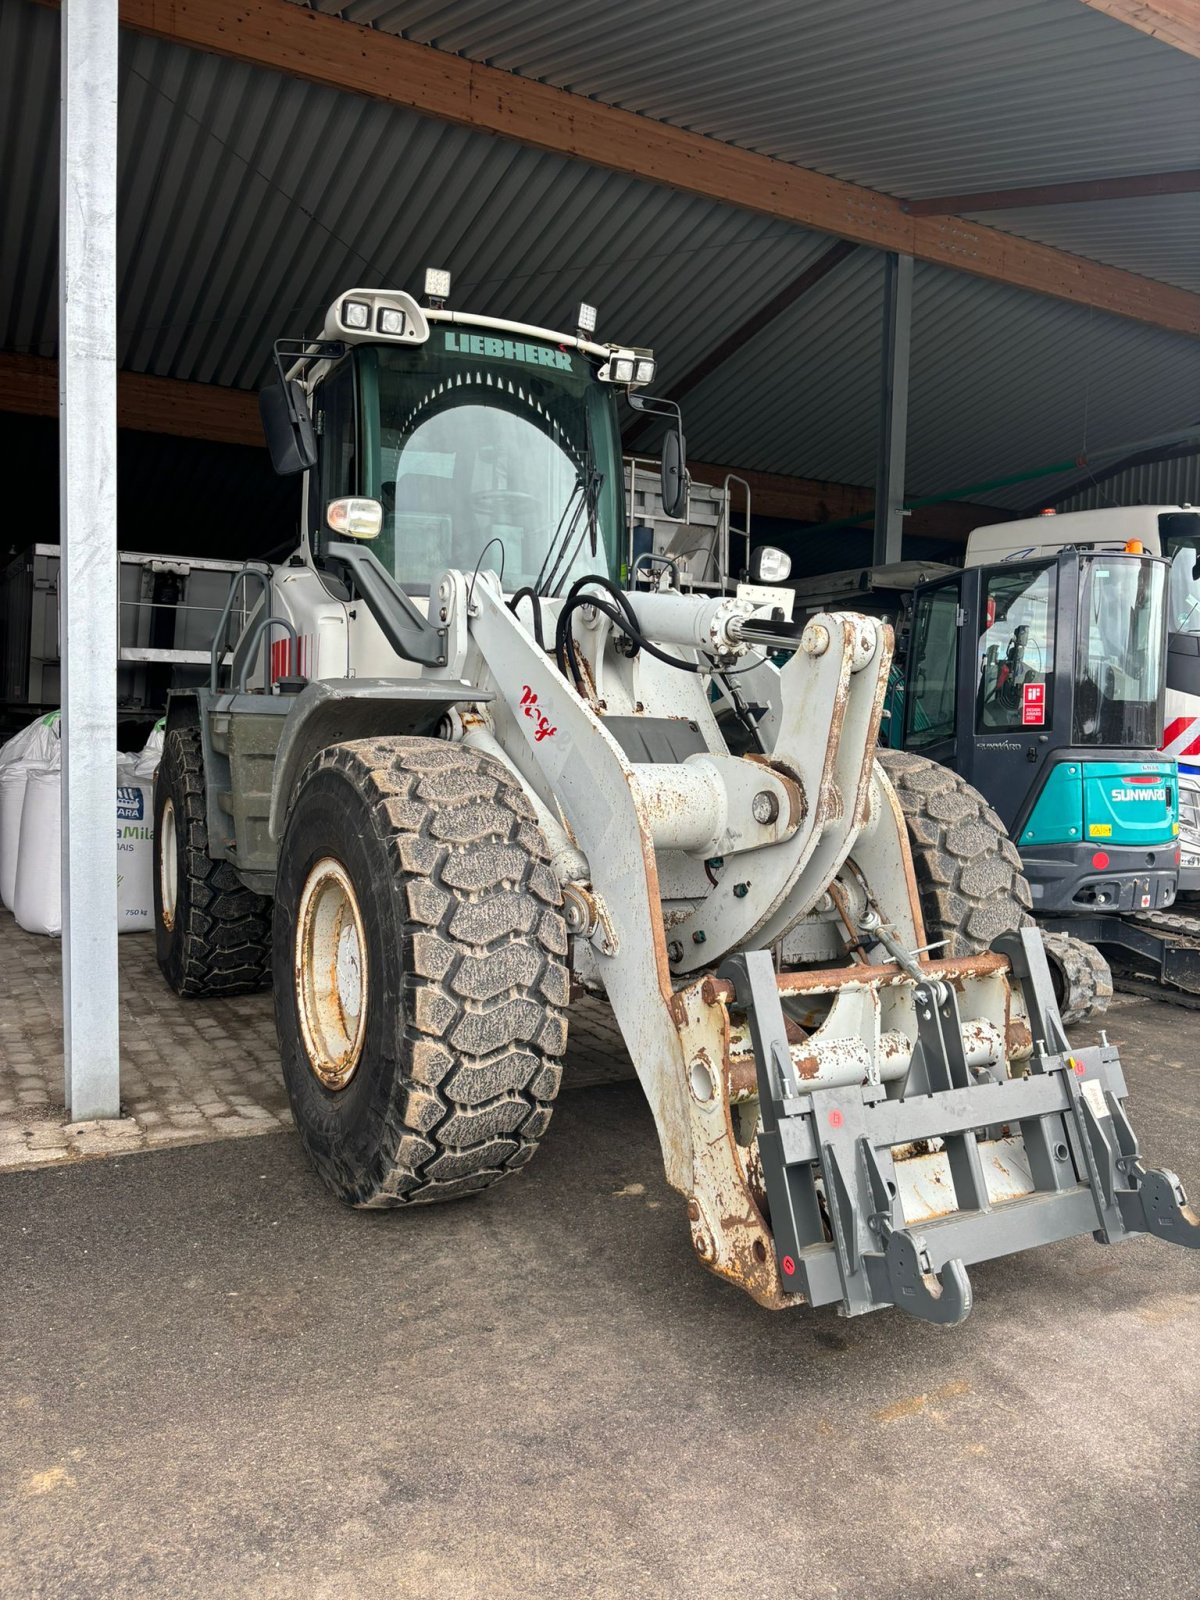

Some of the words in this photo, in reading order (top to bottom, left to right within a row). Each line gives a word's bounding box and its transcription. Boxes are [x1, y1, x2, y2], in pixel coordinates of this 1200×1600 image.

[445, 332, 573, 372] LIEBHERR
[1111, 788, 1165, 802] SUNWARD
[117, 808, 140, 818] ARA
